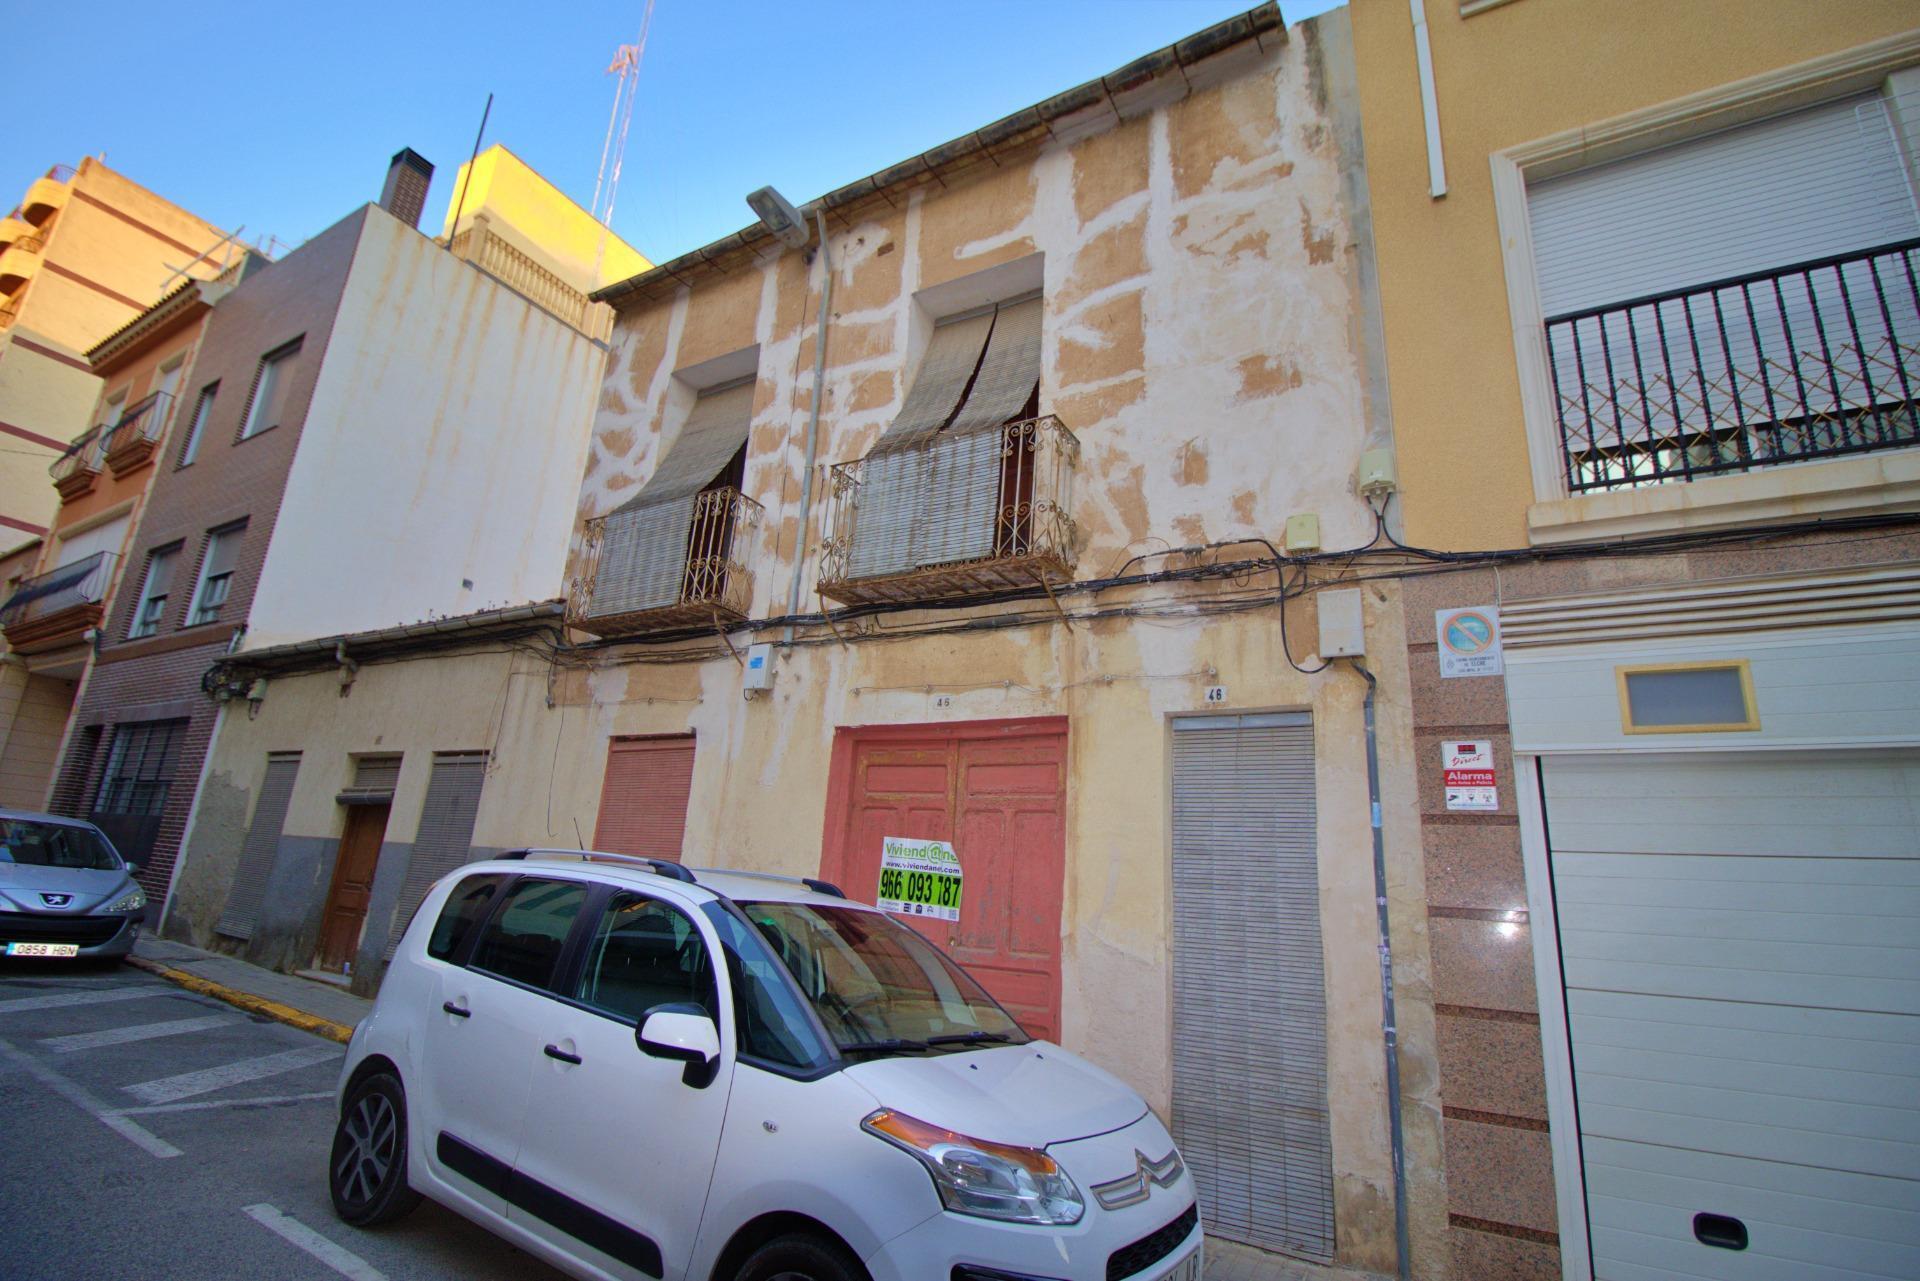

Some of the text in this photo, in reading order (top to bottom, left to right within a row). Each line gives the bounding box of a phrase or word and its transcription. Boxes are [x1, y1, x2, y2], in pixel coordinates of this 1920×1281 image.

[1208, 688, 1222, 701] 46
[1447, 770, 1493, 781] Alarma
[881, 869, 903, 900] 966
[907, 872, 932, 903] 093
[937, 875, 961, 907] 787
